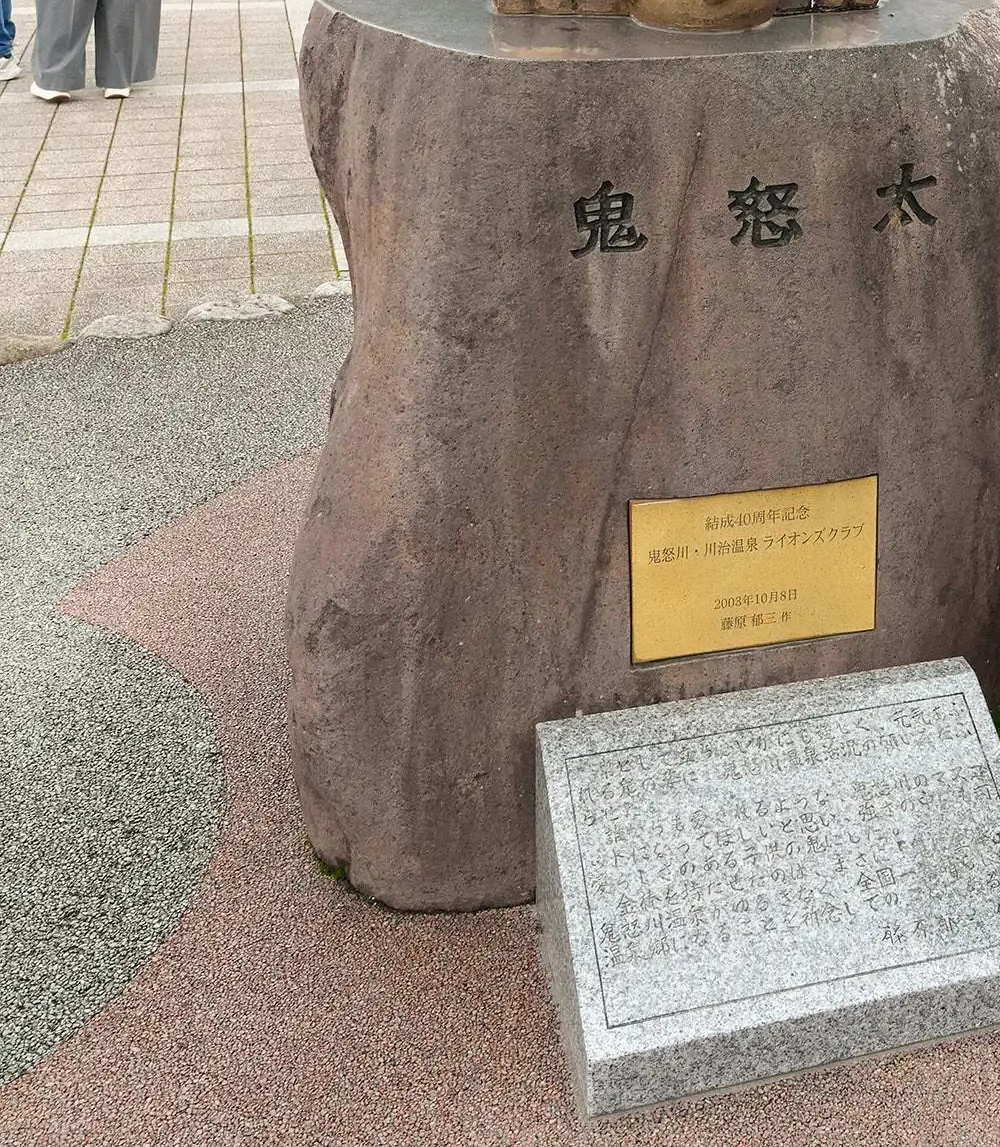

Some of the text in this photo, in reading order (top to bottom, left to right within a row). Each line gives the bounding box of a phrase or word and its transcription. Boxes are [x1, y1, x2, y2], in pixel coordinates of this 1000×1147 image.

[570, 162, 938, 260] 鬼怒太
[704, 504, 811, 532] 結成40周年記念
[648, 522, 865, 565] 鬼怒川・川治温泉 ライオンズクラブ
[713, 588, 798, 610] 2003年10月8日
[720, 611, 792, 632] 藤原 郁三 作
